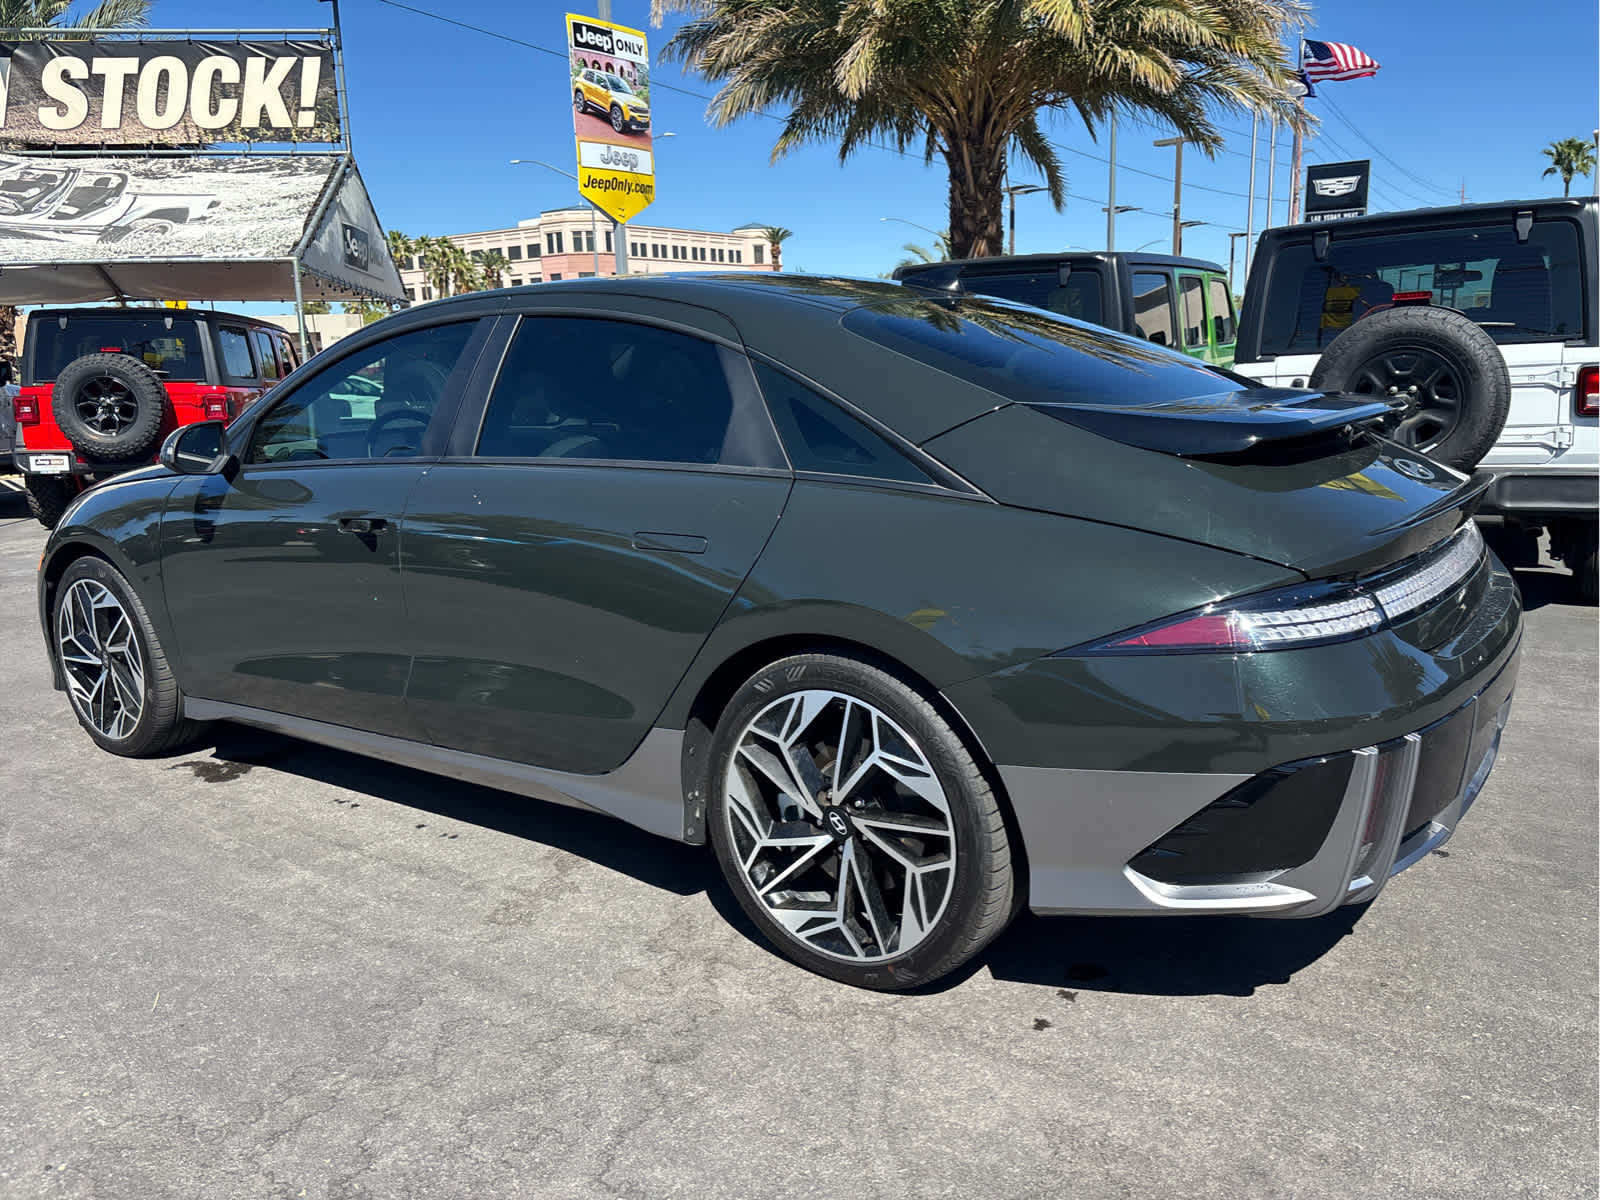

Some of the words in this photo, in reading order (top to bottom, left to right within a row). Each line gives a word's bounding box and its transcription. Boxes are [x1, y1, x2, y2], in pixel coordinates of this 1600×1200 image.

[576, 25, 613, 52] Jeep
[616, 39, 643, 56] ONLY
[38, 56, 321, 130] STOCK!
[600, 145, 639, 172] Jeep
[583, 175, 653, 195] JeepOnly.com
